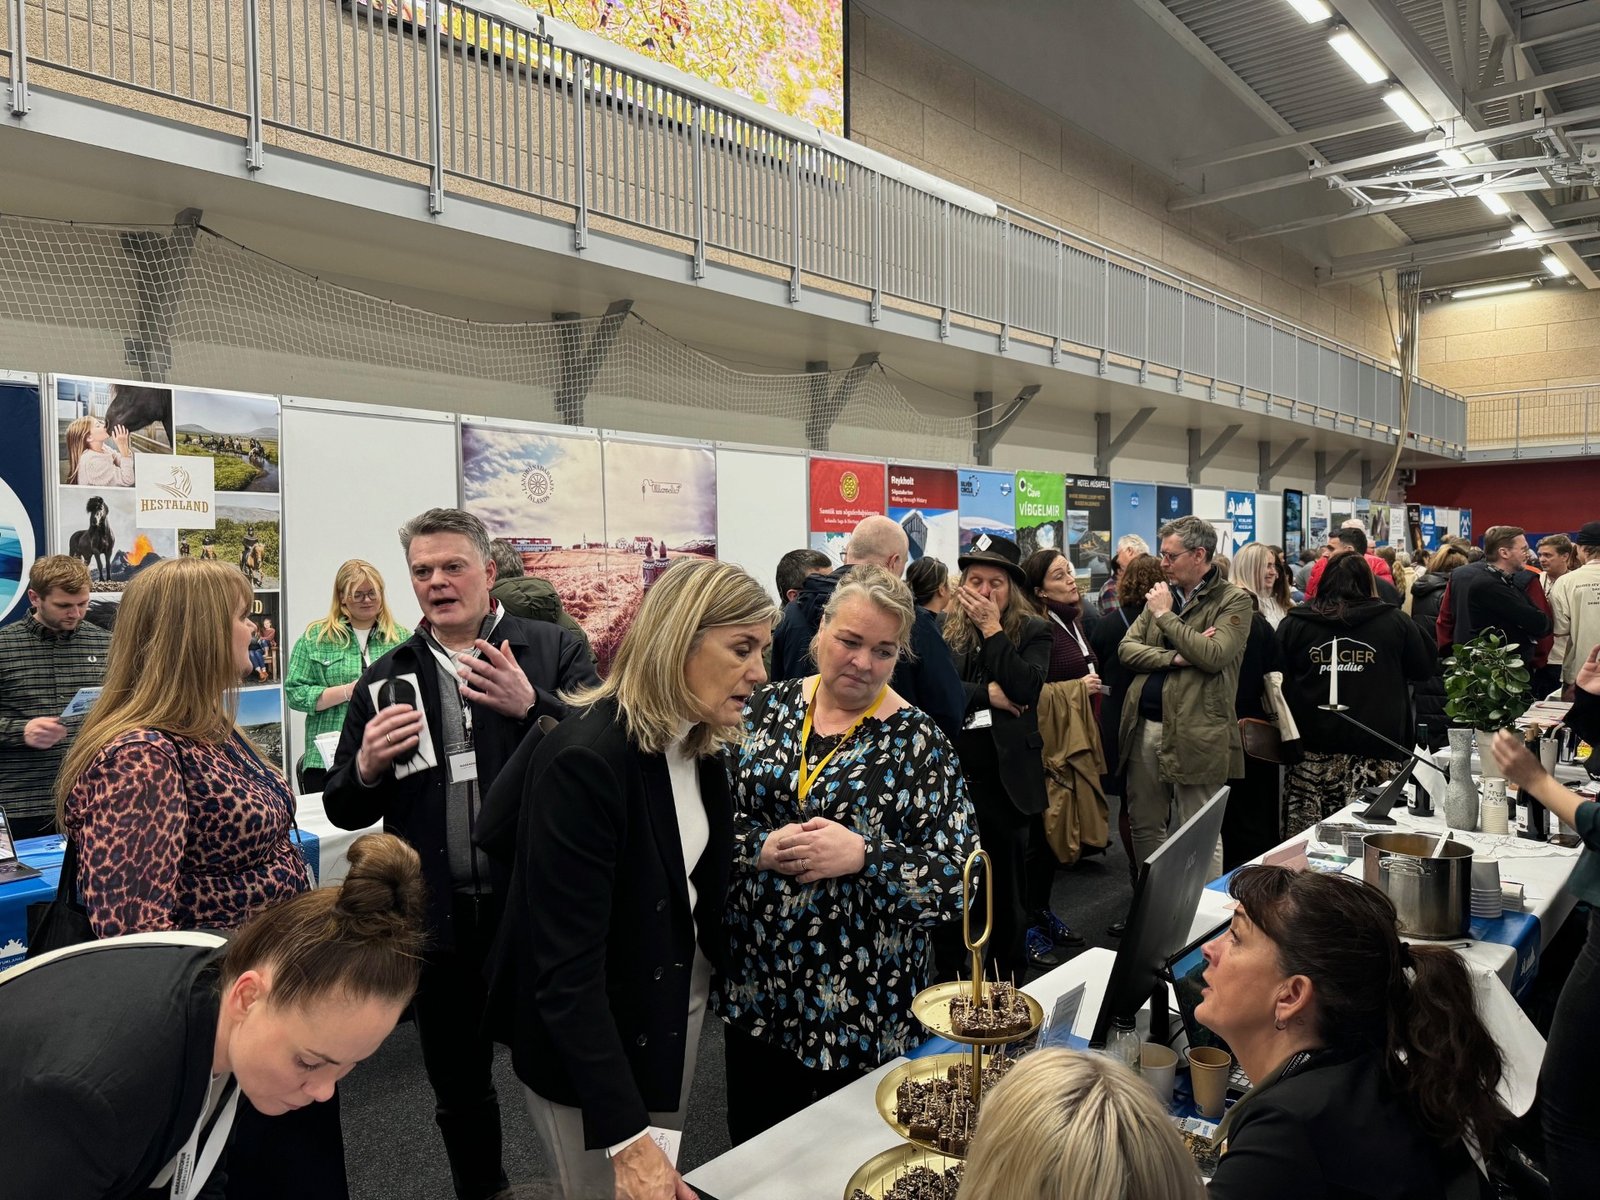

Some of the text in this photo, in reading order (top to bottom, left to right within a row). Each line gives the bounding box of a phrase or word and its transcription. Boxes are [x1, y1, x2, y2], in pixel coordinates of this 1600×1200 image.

[890, 475, 914, 486] Reykholt
[1076, 479, 1090, 487] HOTEL
[1027, 487, 1041, 497] Cave
[140, 499, 209, 513] HESTALAND
[1019, 501, 1060, 516] VÍÐGELMIR
[1319, 662, 1364, 675] paadise
